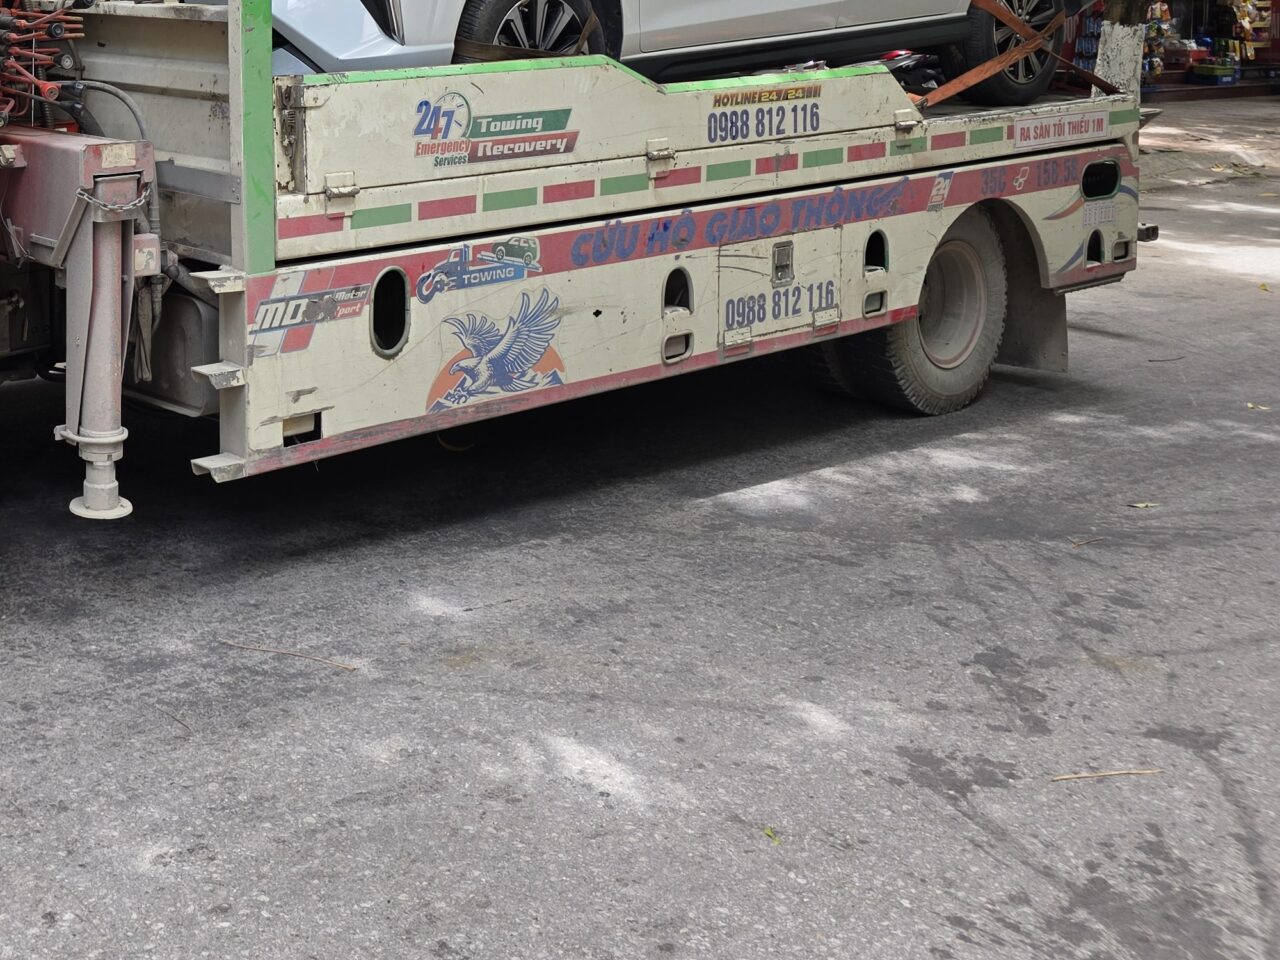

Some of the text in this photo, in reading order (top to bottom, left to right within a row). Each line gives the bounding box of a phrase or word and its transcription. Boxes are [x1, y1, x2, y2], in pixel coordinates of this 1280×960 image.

[713, 89, 759, 108] HOTLINE
[477, 115, 544, 133] Towing
[707, 102, 820, 143] 0988 812 116
[1019, 128, 1032, 142] RA
[1033, 122, 1051, 139] SÀN
[1052, 116, 1066, 137] TỐI
[1091, 117, 1104, 133] 1M
[415, 141, 471, 156] Emergency
[477, 137, 568, 157] Recovery
[433, 154, 467, 168] Services
[705, 206, 781, 245] GIAO
[462, 267, 515, 285] TOWING
[336, 302, 362, 318] port
[724, 279, 835, 329] 0988 812 116
